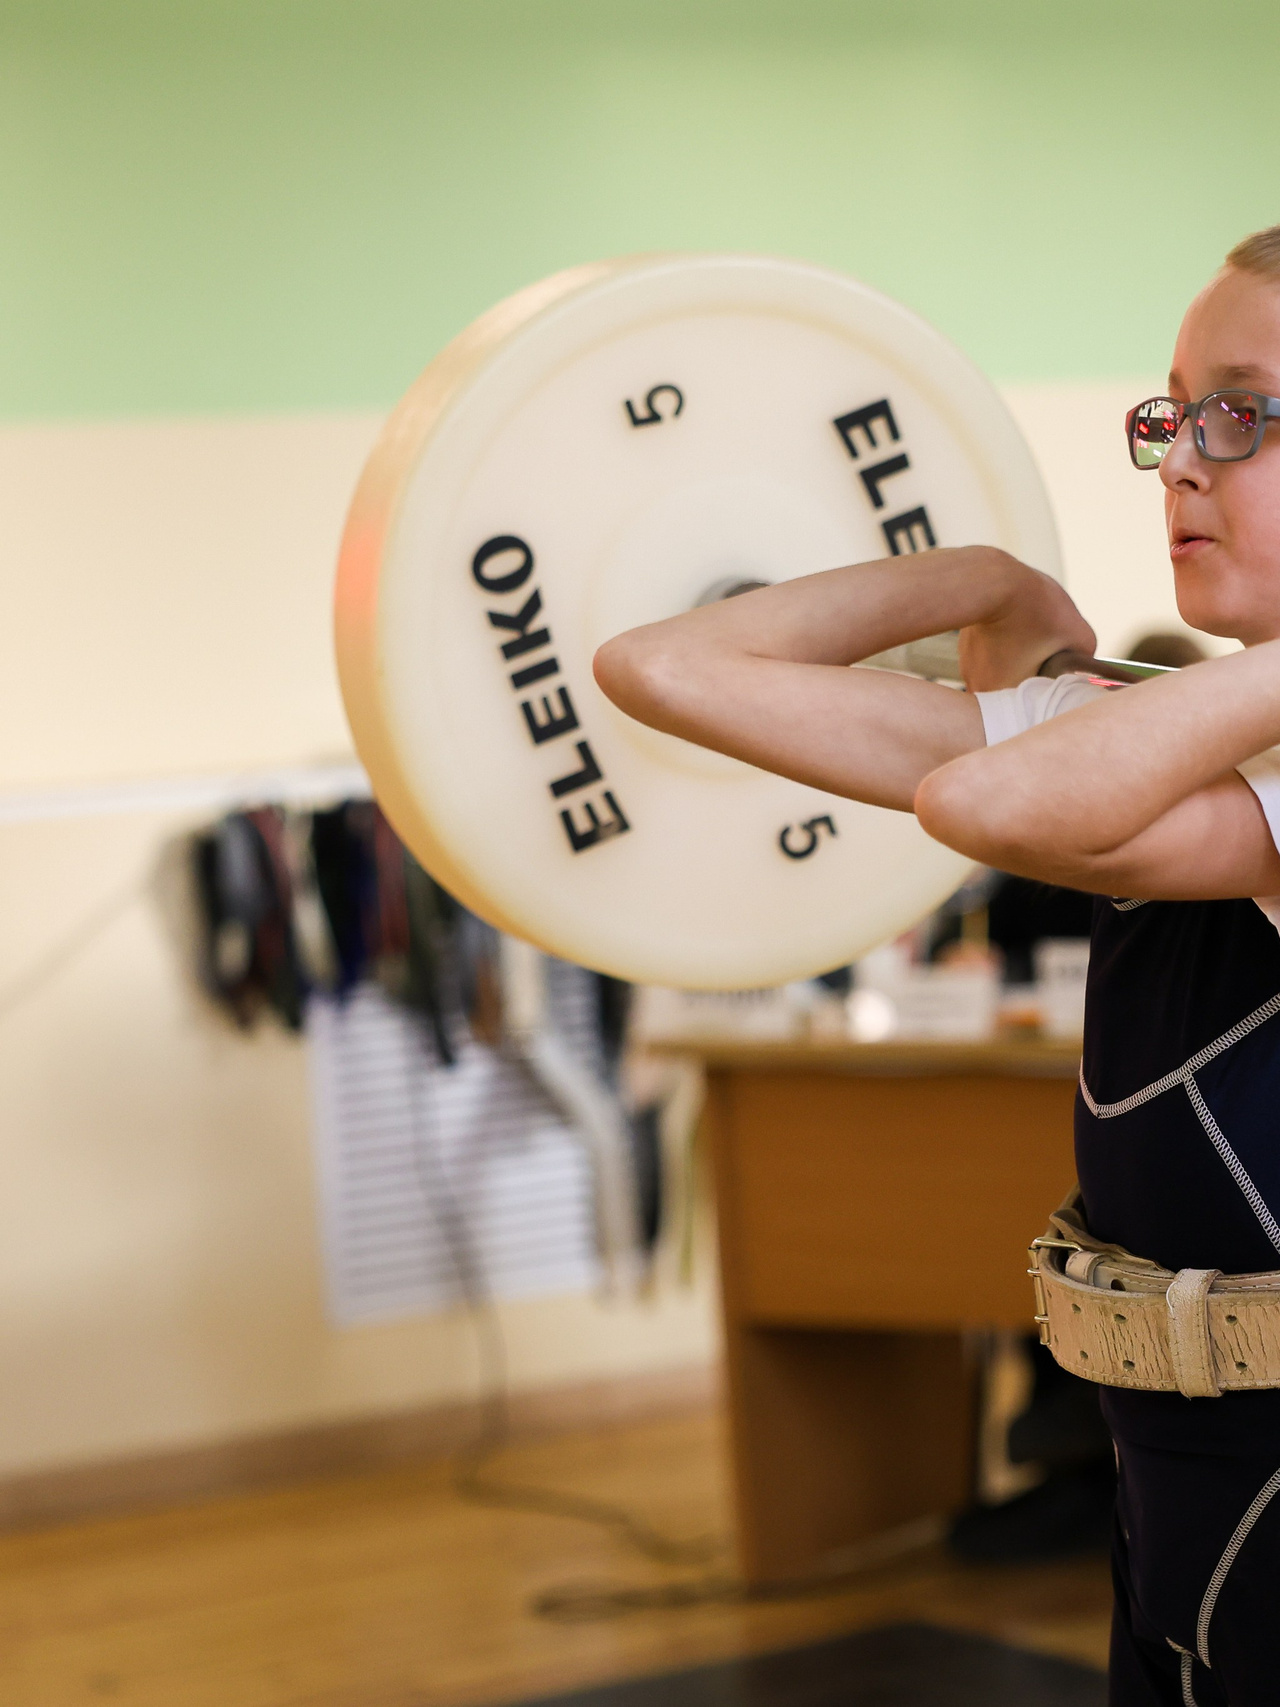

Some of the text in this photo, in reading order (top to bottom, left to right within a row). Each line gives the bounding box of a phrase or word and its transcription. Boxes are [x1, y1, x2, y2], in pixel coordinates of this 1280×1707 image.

[624, 383, 685, 429] 5
[831, 397, 938, 559] ELE
[469, 533, 632, 855] ELEIKO
[777, 813, 840, 862] 5
